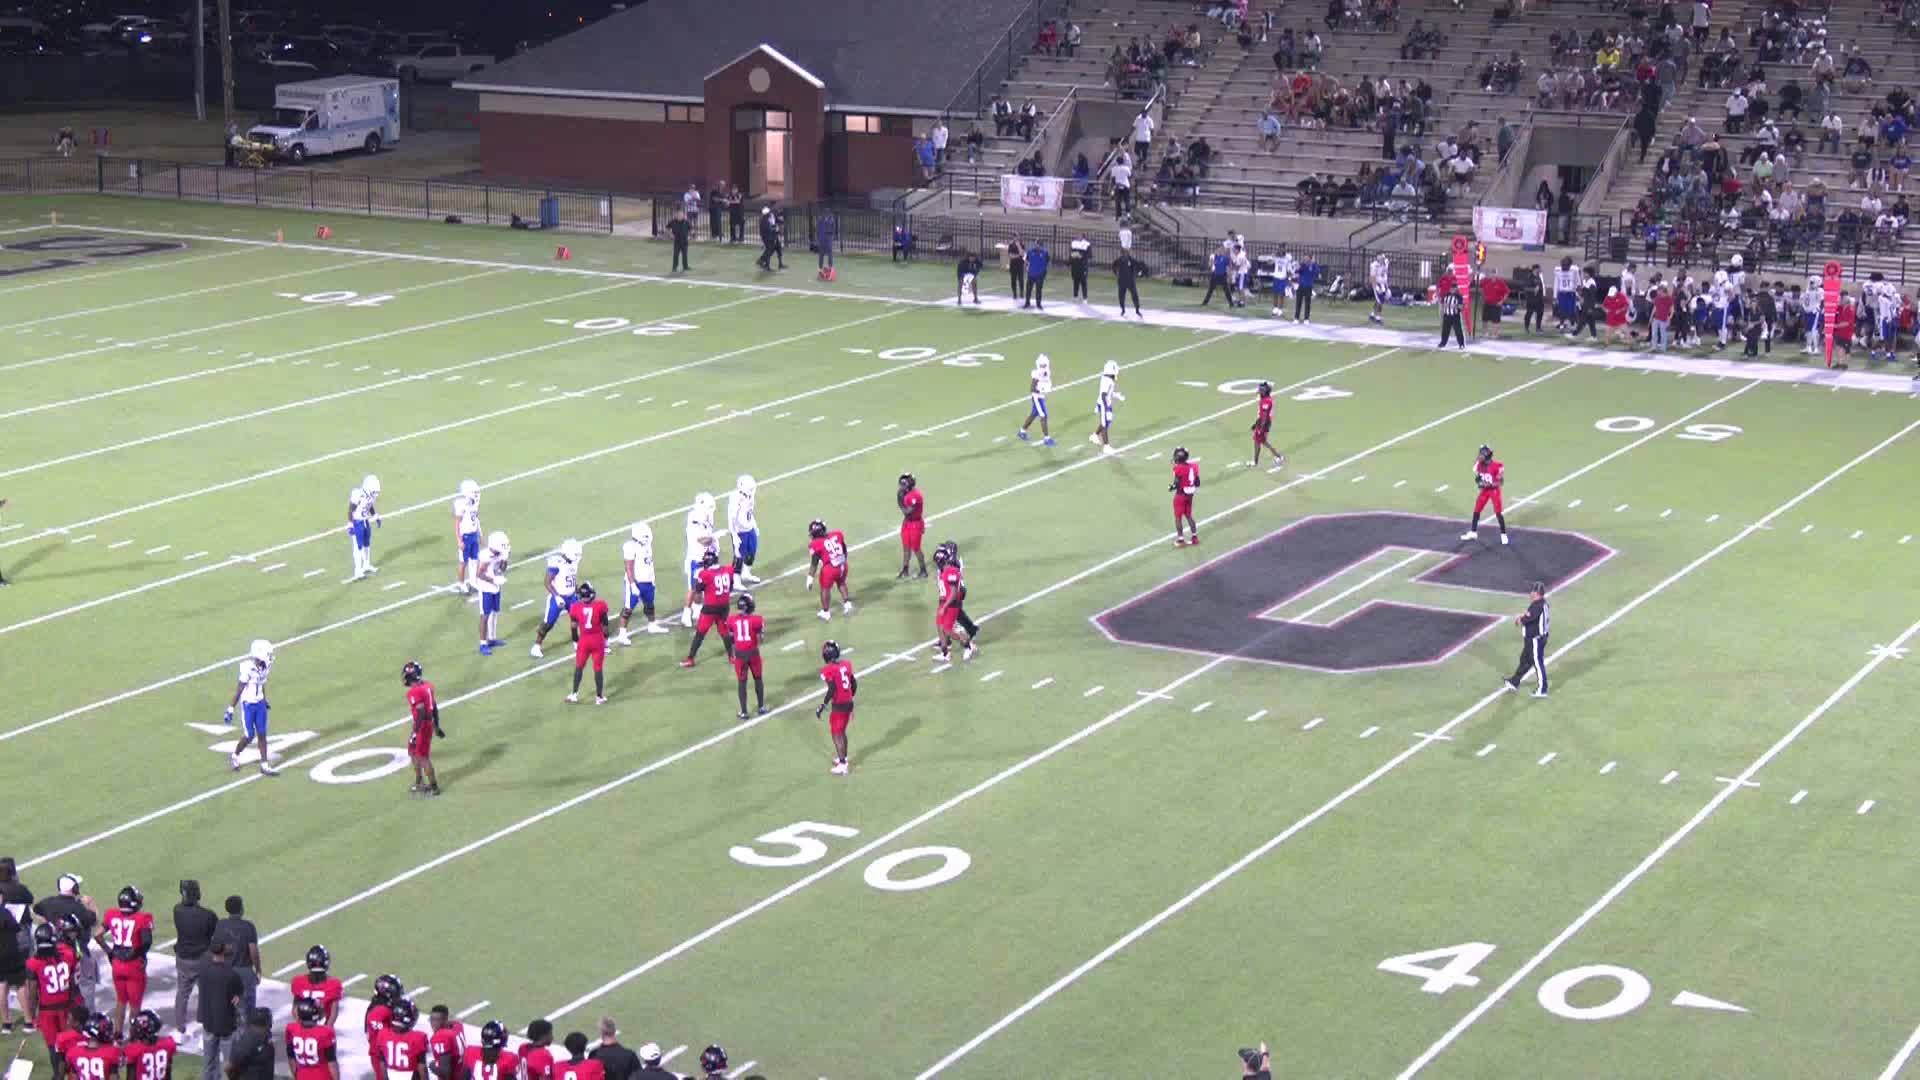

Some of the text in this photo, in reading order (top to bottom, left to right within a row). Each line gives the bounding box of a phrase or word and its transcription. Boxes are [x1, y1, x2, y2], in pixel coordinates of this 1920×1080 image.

[573, 317, 700, 336] 20
[877, 347, 1005, 367] 30
[1217, 378, 1355, 401] 40
[1594, 416, 1744, 441] 50
[823, 535, 843, 557] 95
[714, 573, 731, 596] 99
[583, 607, 593, 629] 7
[735, 620, 751, 642] 11
[839, 666, 850, 690] 5
[728, 821, 972, 891] 50
[110, 917, 136, 947] 37
[43, 961, 70, 993] 32
[1376, 942, 1651, 1020] 40
[292, 1036, 320, 1066] 29
[386, 1041, 410, 1068] 16
[76, 1056, 105, 1080] 39
[141, 1049, 169, 1080] 38
